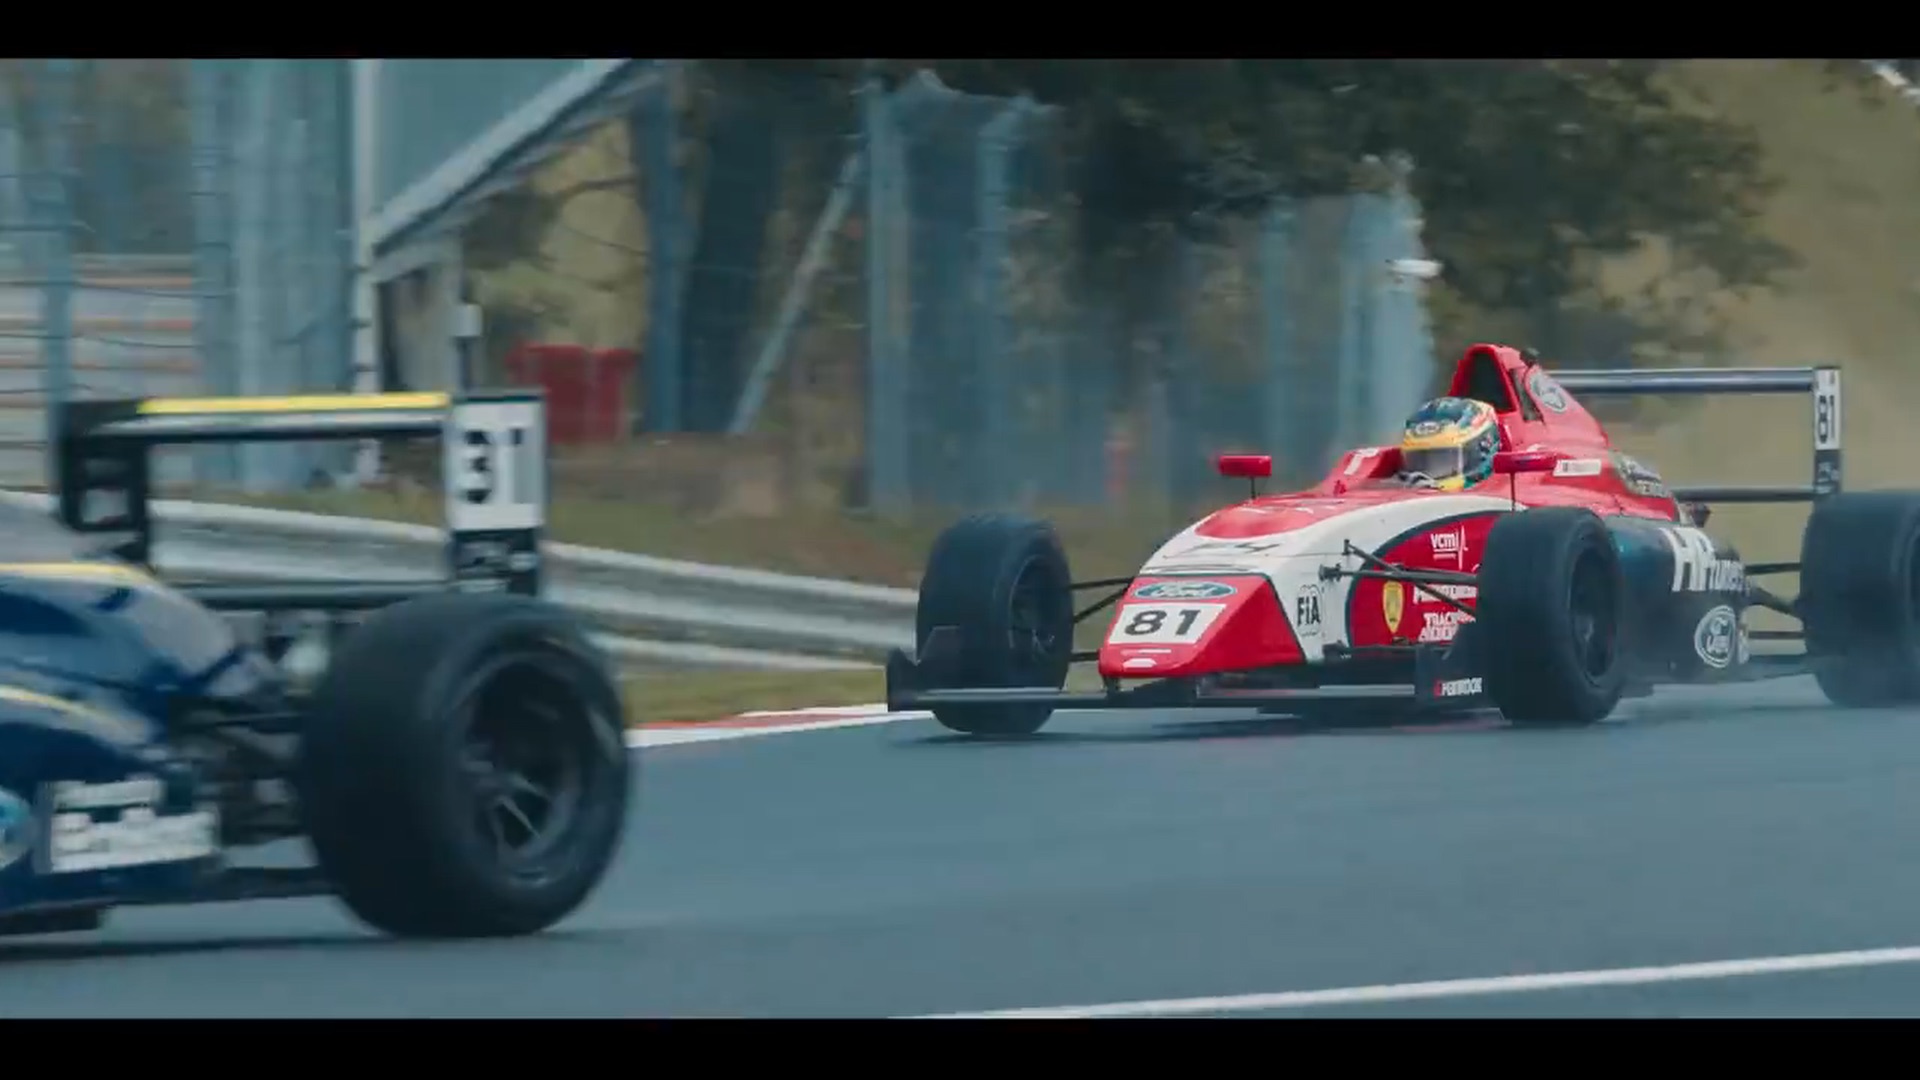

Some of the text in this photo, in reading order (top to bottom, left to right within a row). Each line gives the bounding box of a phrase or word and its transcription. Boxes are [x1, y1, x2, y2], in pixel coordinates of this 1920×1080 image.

[1818, 394, 1836, 444] 81
[463, 429, 537, 505] 31
[1124, 608, 1202, 636] 81
[1297, 596, 1321, 626] FIA
